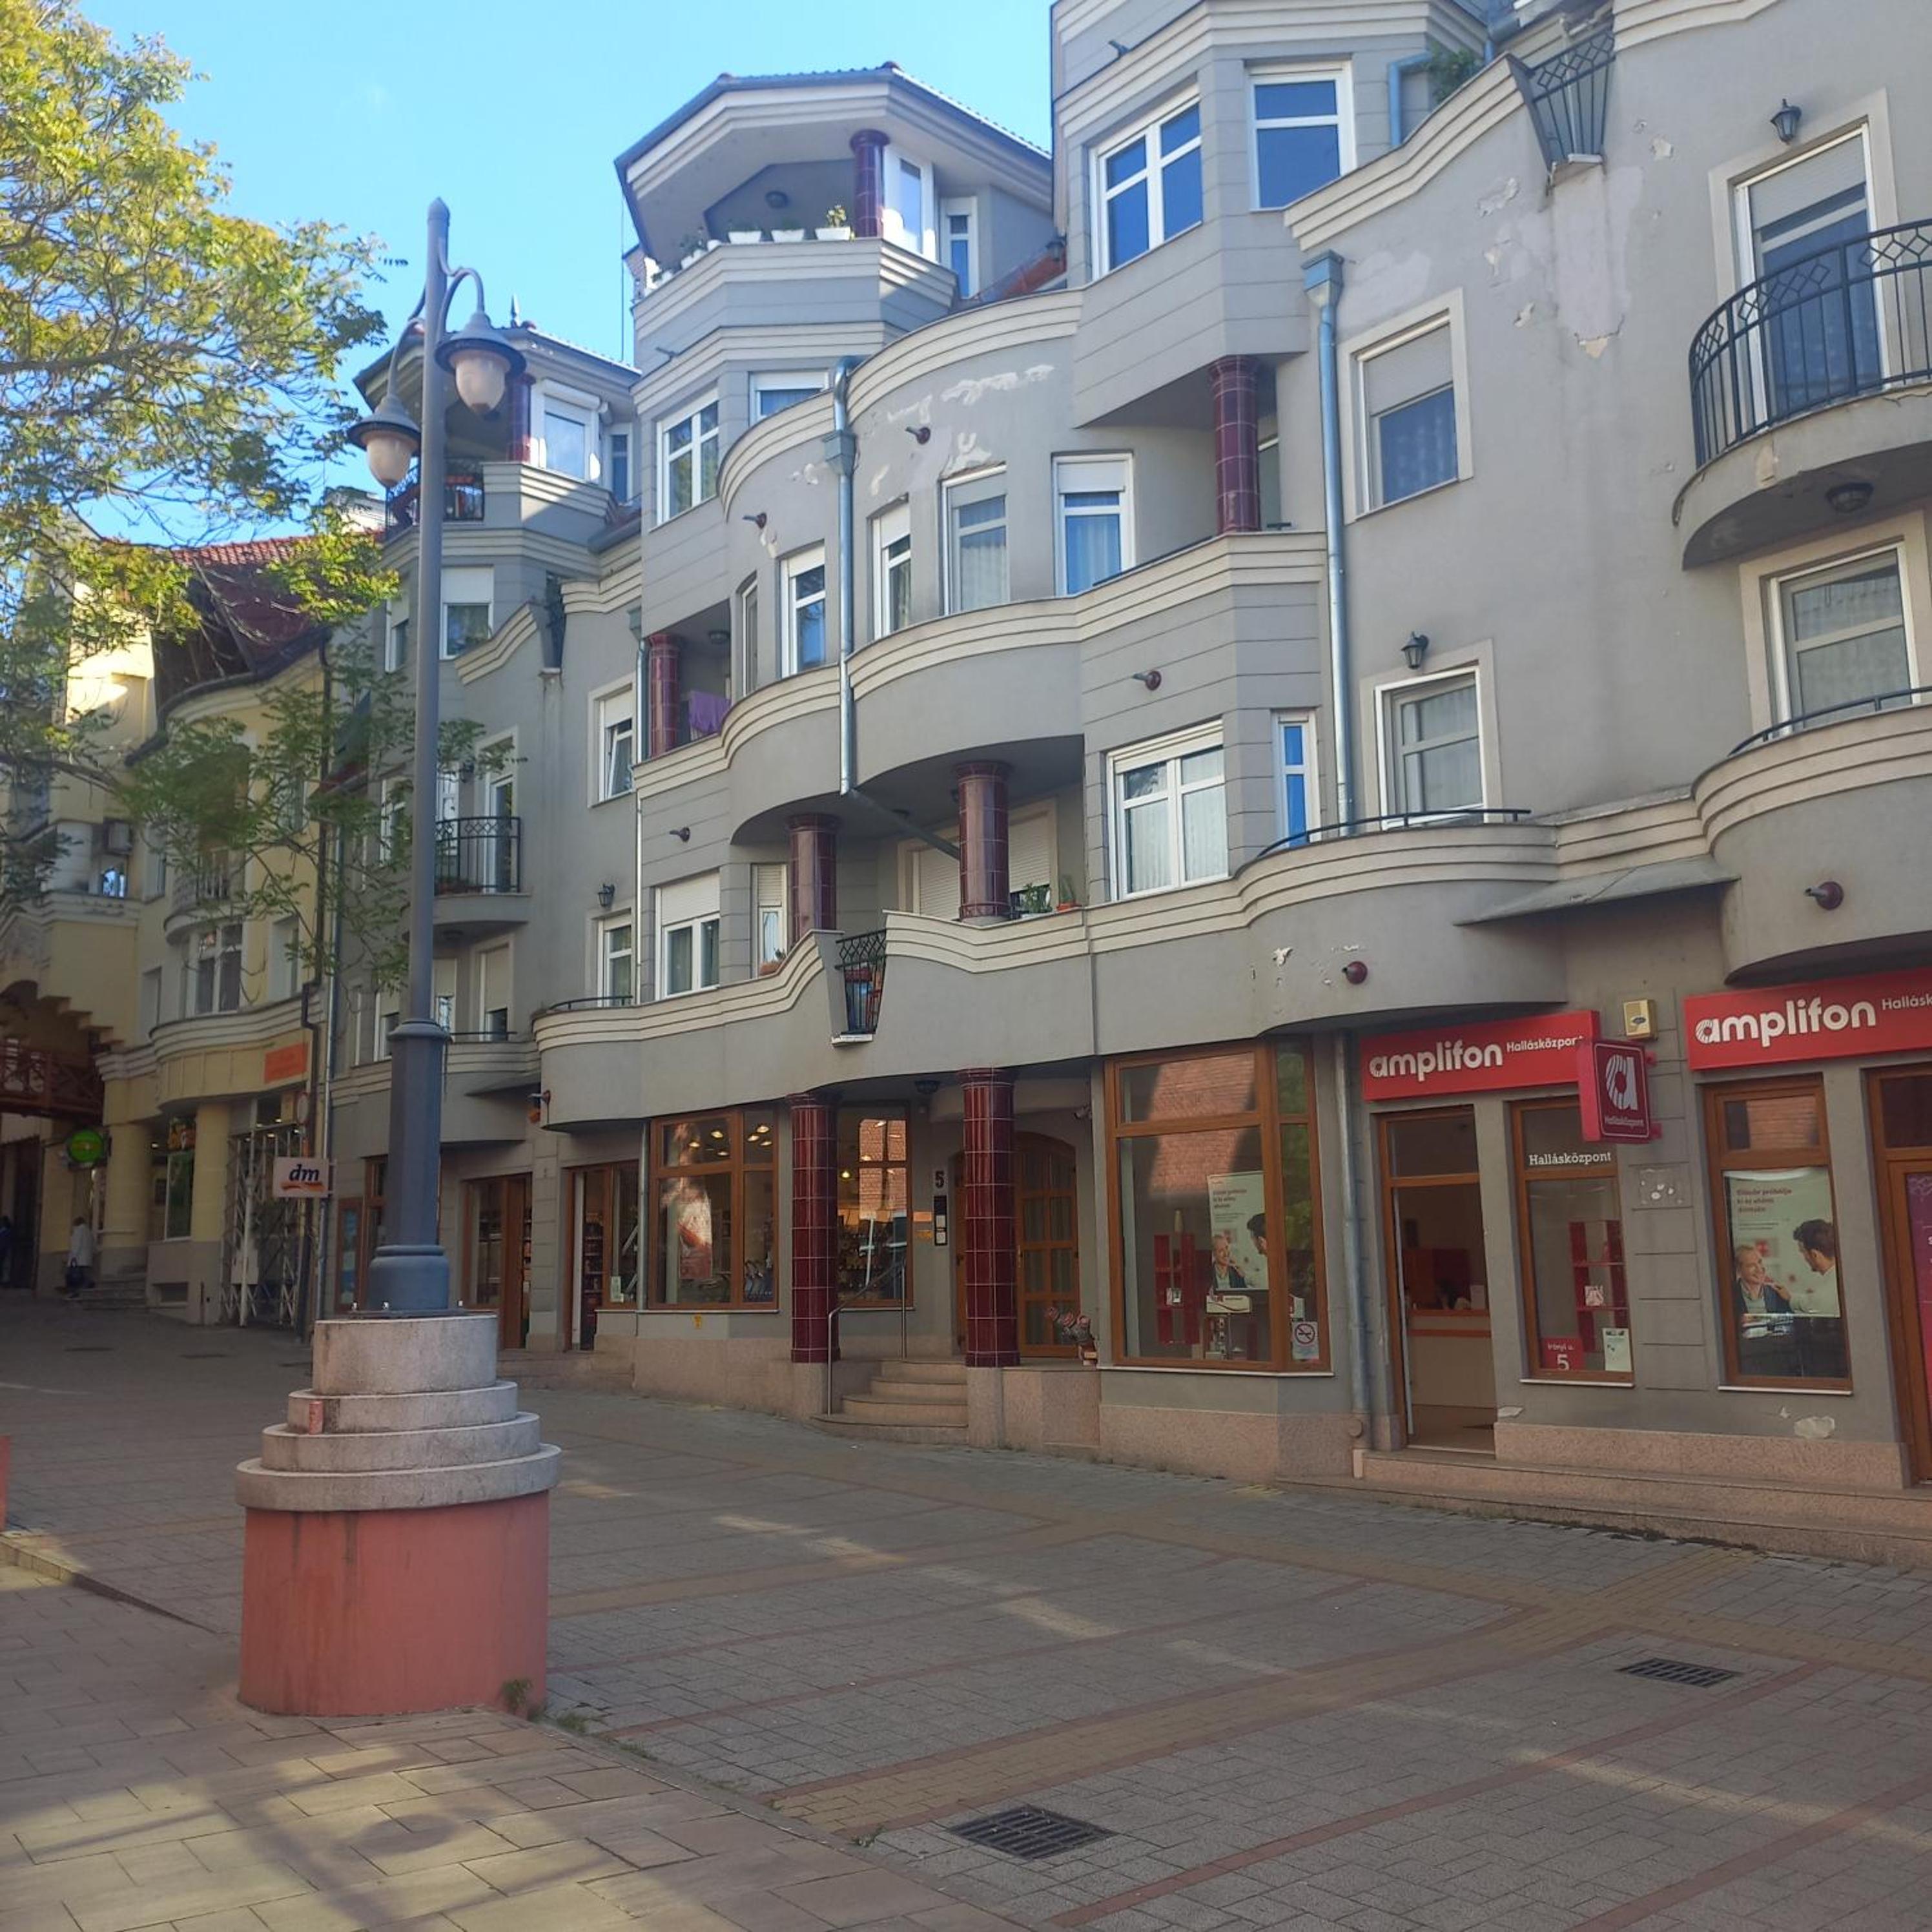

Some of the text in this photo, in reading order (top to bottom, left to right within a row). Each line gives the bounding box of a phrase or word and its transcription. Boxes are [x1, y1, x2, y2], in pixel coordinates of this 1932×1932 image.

[1695, 997, 1876, 1048] amplifon
[1369, 1039, 1503, 1082] amplifon
[1528, 1151, 1612, 1166] Hallásközpont
[289, 1164, 320, 1182] dm
[935, 1170, 945, 1188] 5
[1557, 1353, 1570, 1371] 5
